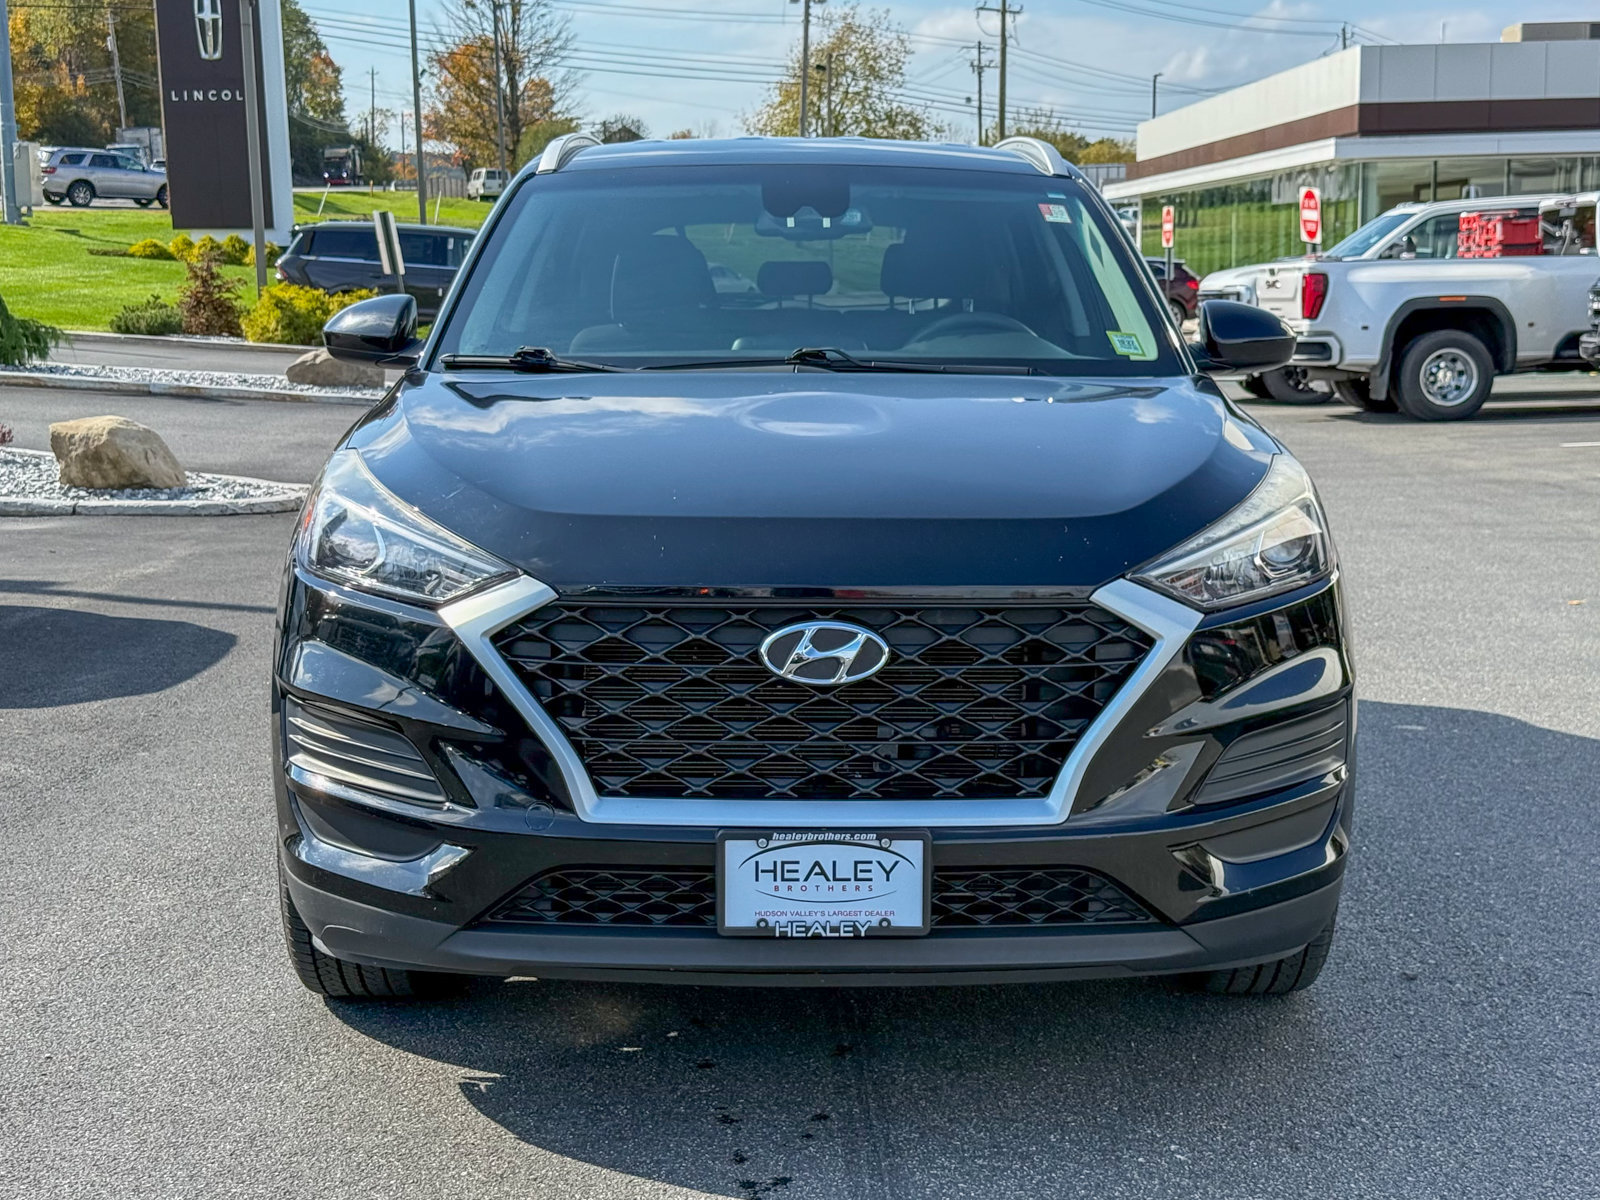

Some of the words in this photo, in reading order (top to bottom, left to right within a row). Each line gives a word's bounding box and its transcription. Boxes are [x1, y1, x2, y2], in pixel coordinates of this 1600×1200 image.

[170, 89, 244, 102] LINCOL
[772, 832, 877, 842] healeybrothers.com
[754, 860, 900, 882] HEALEY
[774, 884, 874, 892] BROTHERS
[775, 921, 872, 938] HEALEY
